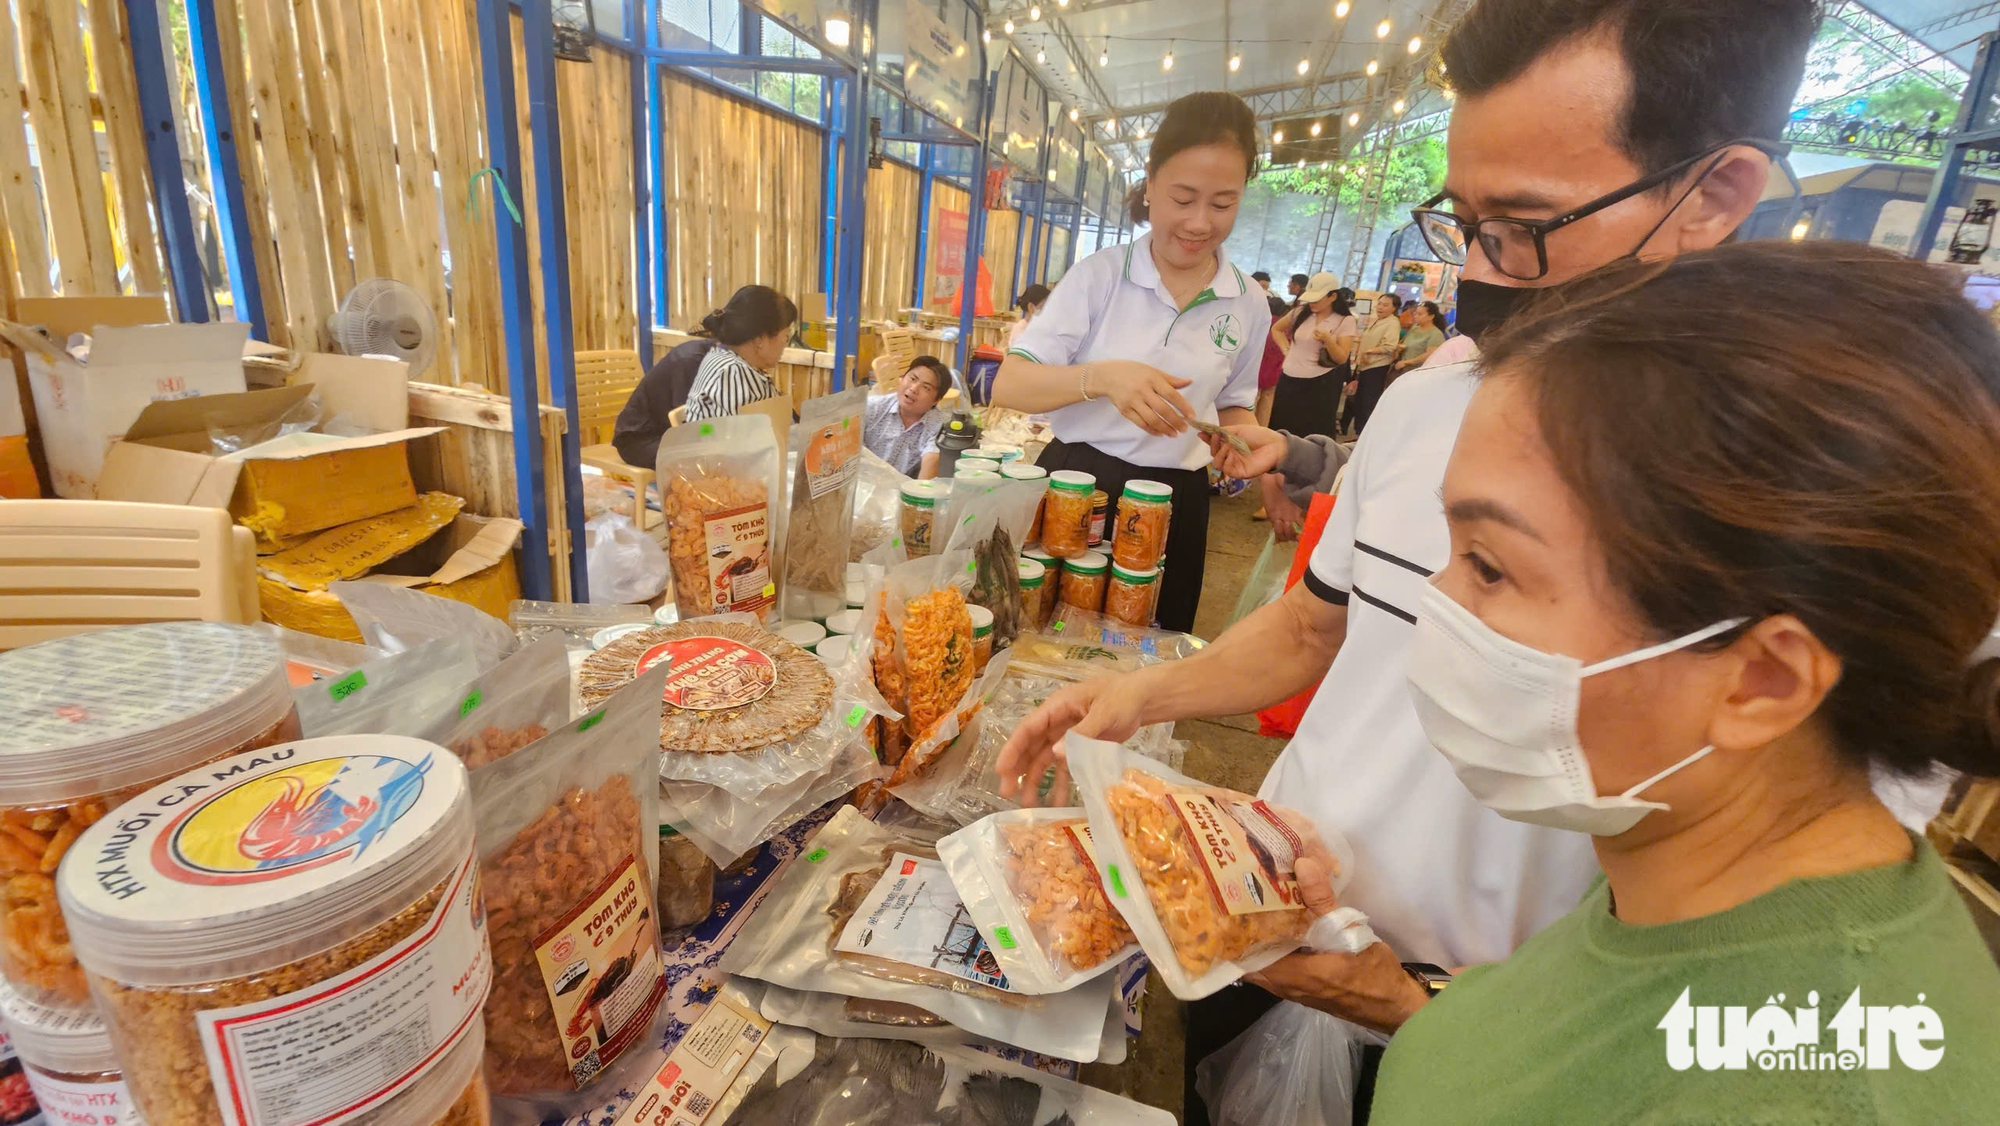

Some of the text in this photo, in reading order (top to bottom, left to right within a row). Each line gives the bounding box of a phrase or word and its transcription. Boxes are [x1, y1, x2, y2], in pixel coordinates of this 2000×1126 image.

[668, 659, 693, 677] ÁNH
[96, 748, 295, 900] HTX MUỐI CÀ MAU
[1206, 834, 1228, 869] TÔM
[583, 877, 636, 938] TÔM KHÔ
[605, 926, 615, 938] 9
